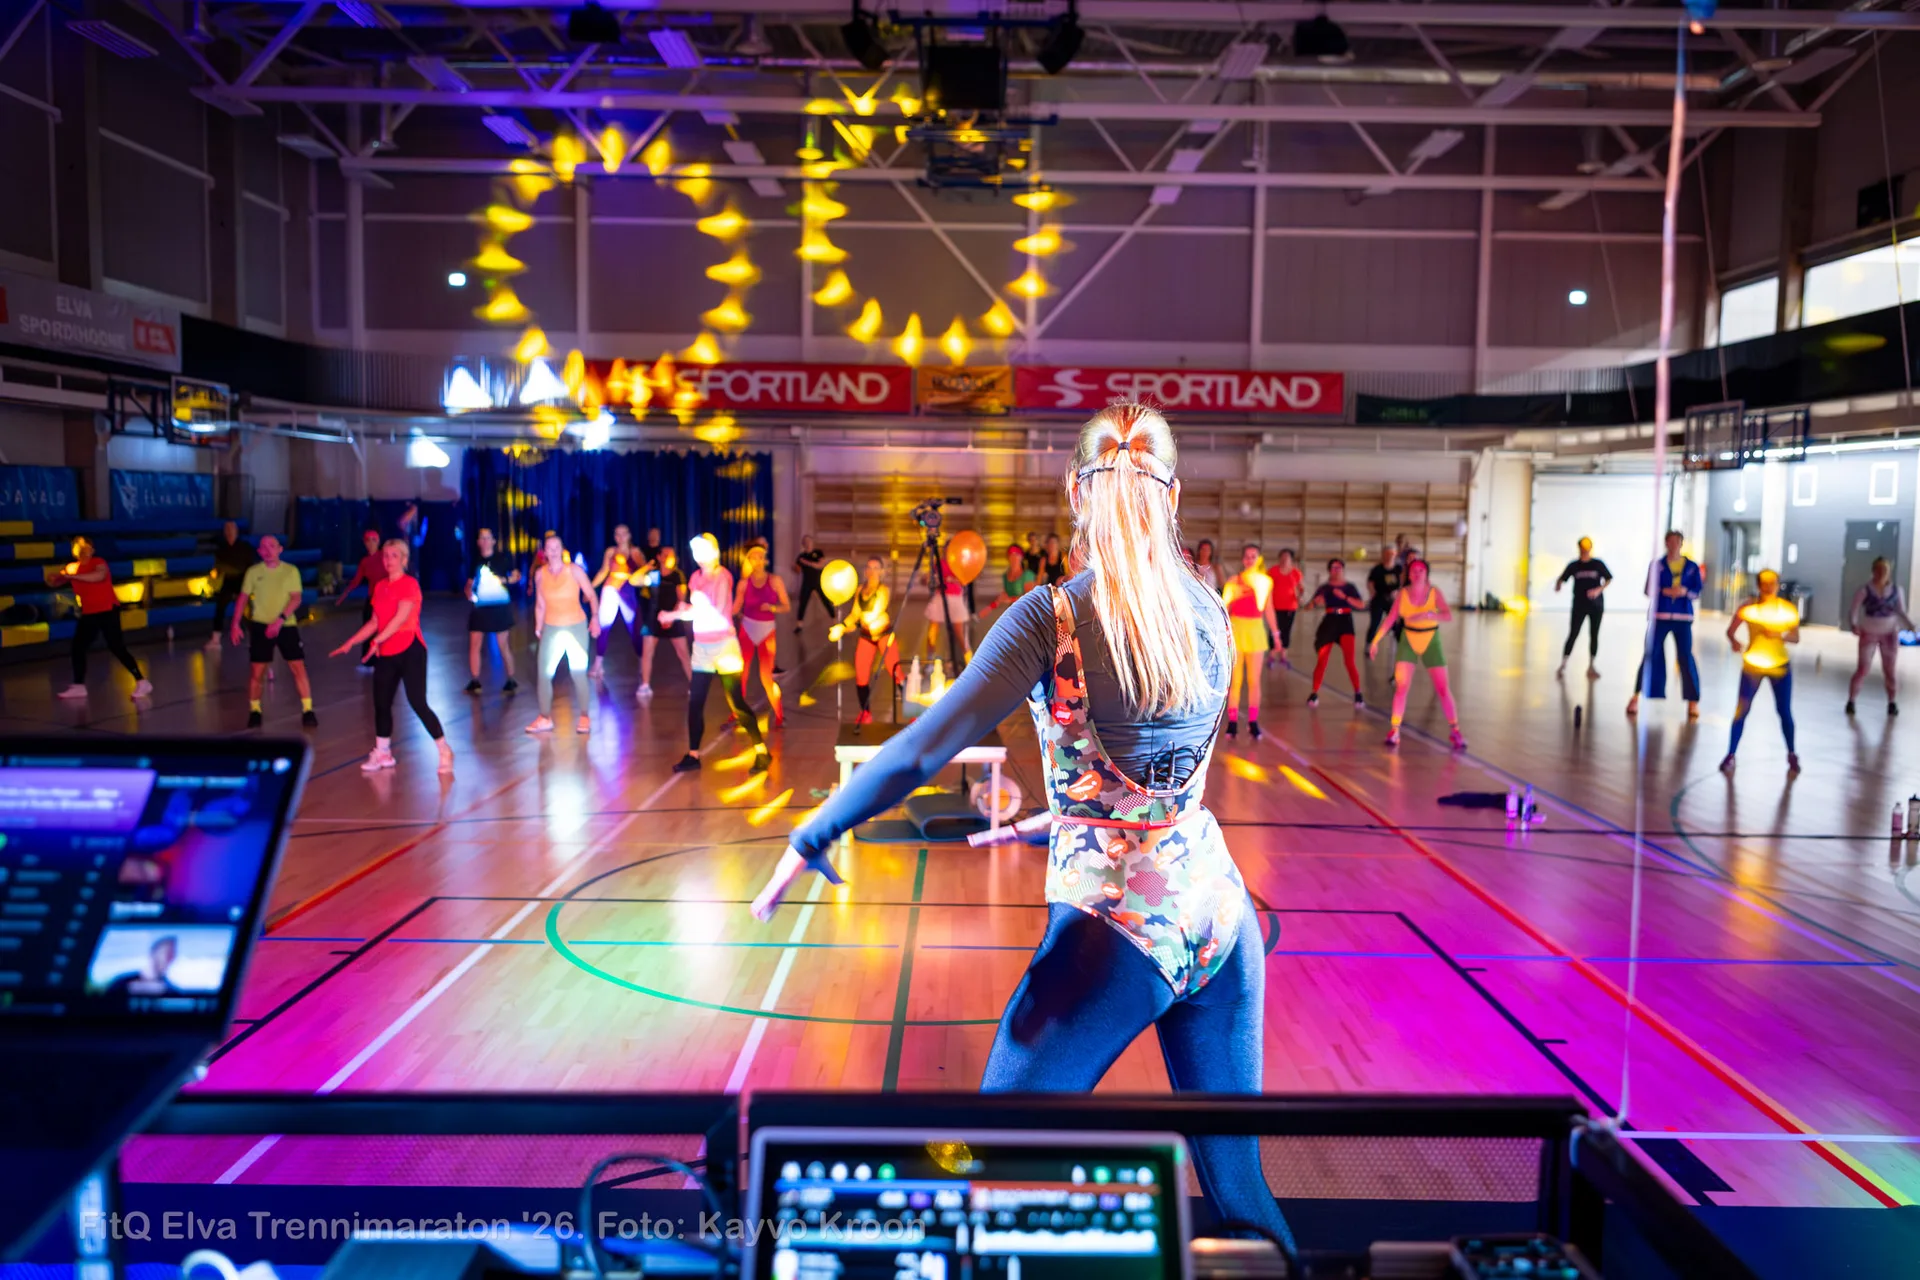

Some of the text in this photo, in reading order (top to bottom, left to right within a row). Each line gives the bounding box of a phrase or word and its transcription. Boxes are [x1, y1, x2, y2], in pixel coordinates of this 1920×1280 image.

[55, 294, 93, 319] ELVA
[675, 368, 890, 404] SPORTLAND
[1105, 372, 1322, 408] SPORTLAND
